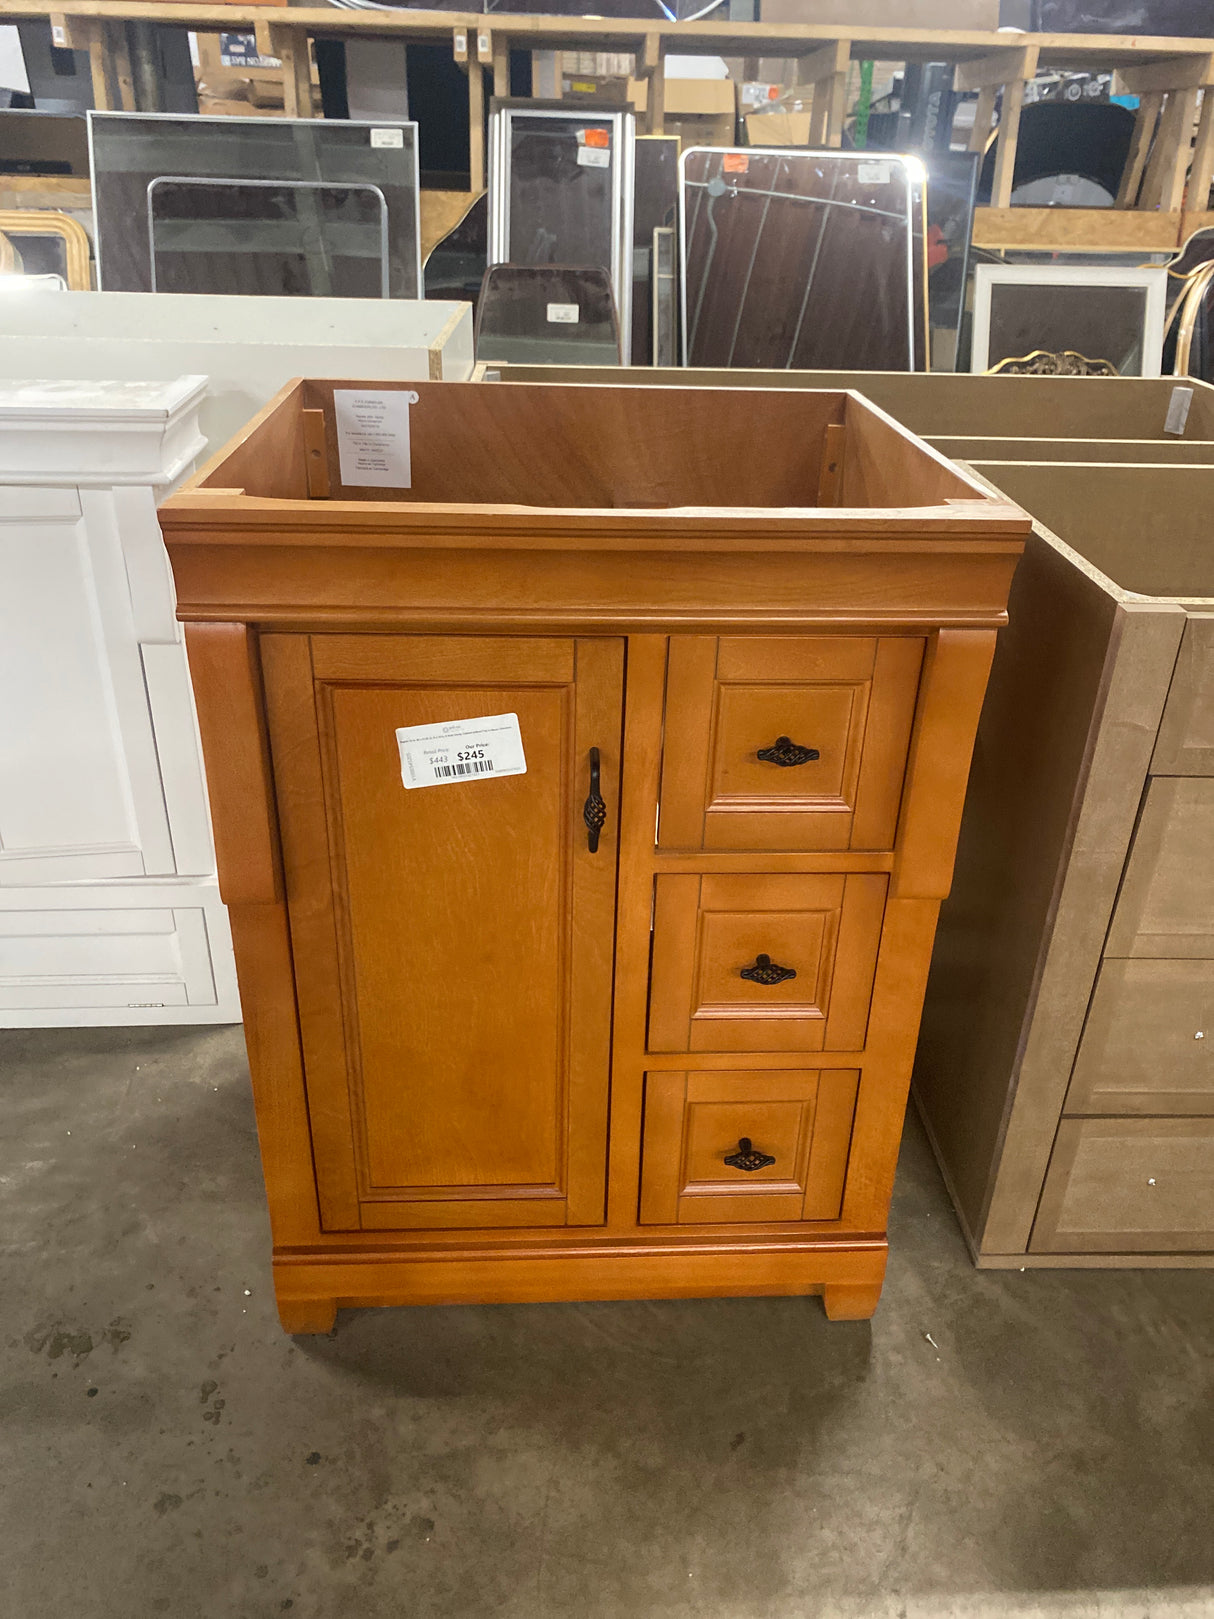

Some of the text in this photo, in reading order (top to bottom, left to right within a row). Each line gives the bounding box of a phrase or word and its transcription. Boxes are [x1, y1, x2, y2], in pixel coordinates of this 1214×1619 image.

[923, 91, 942, 153] OYOTA
[429, 755, 448, 765] $443
[457, 749, 485, 762] $245
